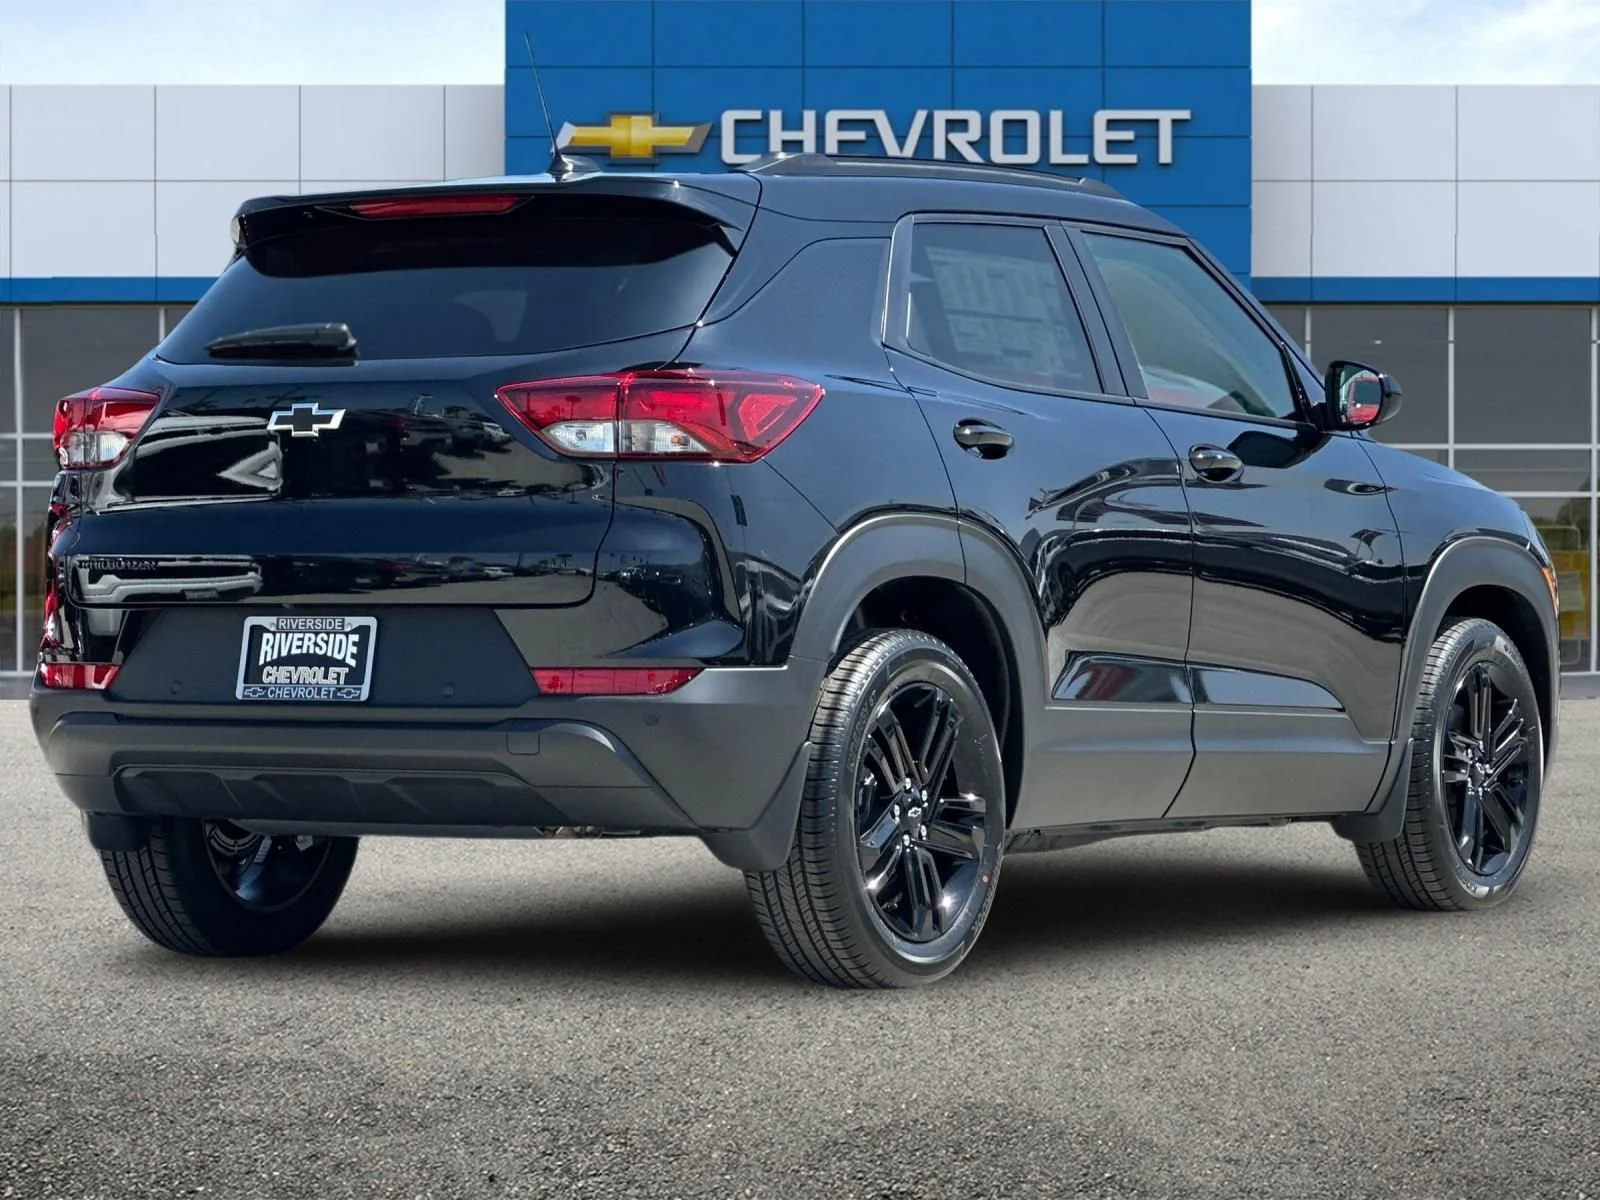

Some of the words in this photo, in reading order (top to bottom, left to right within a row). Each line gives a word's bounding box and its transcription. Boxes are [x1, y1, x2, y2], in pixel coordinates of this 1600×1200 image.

[721, 109, 1191, 164] CHEVROLET
[278, 618, 343, 630] RIVERSIDE
[258, 632, 360, 668] RIVERSIDE
[262, 666, 349, 685] CHEVROLET
[267, 687, 336, 699] CHEVROLET
